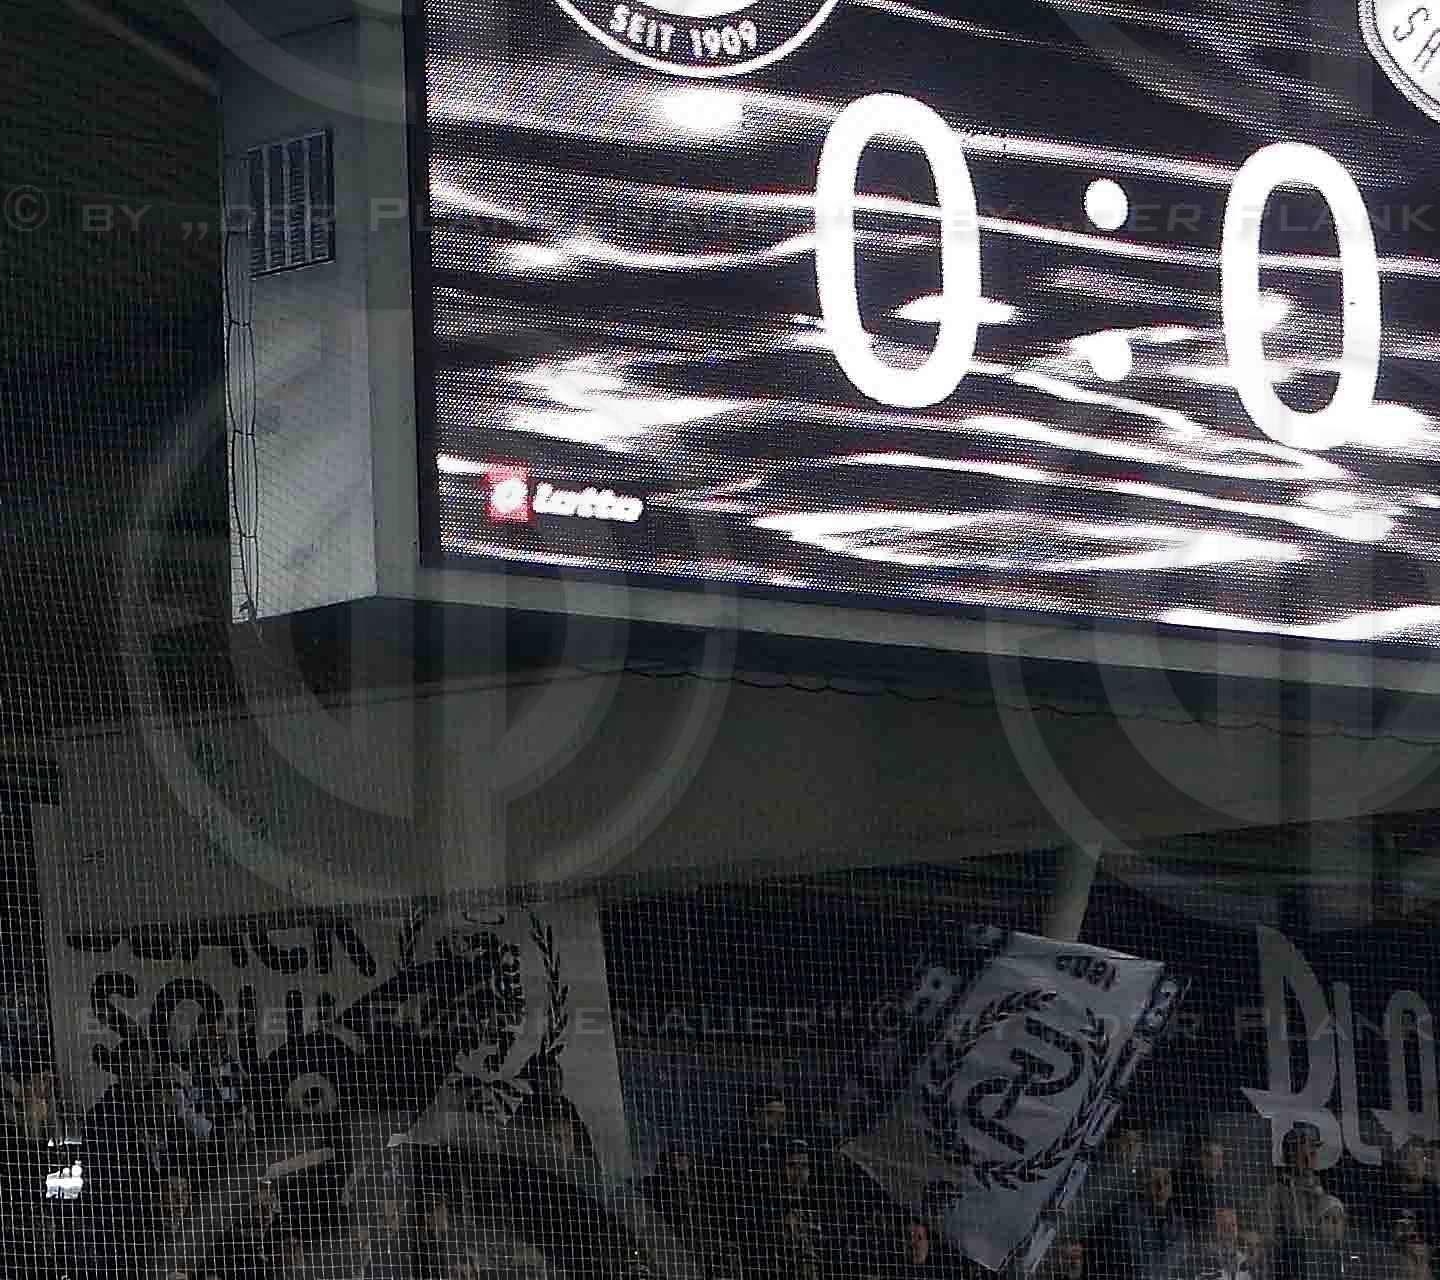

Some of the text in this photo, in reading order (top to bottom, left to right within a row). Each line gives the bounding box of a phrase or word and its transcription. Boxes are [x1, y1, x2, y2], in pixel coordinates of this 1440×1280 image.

[610, 6, 758, 57] SEIT 1909
[815, 92, 980, 407] 0
[1222, 142, 1380, 449] 0
